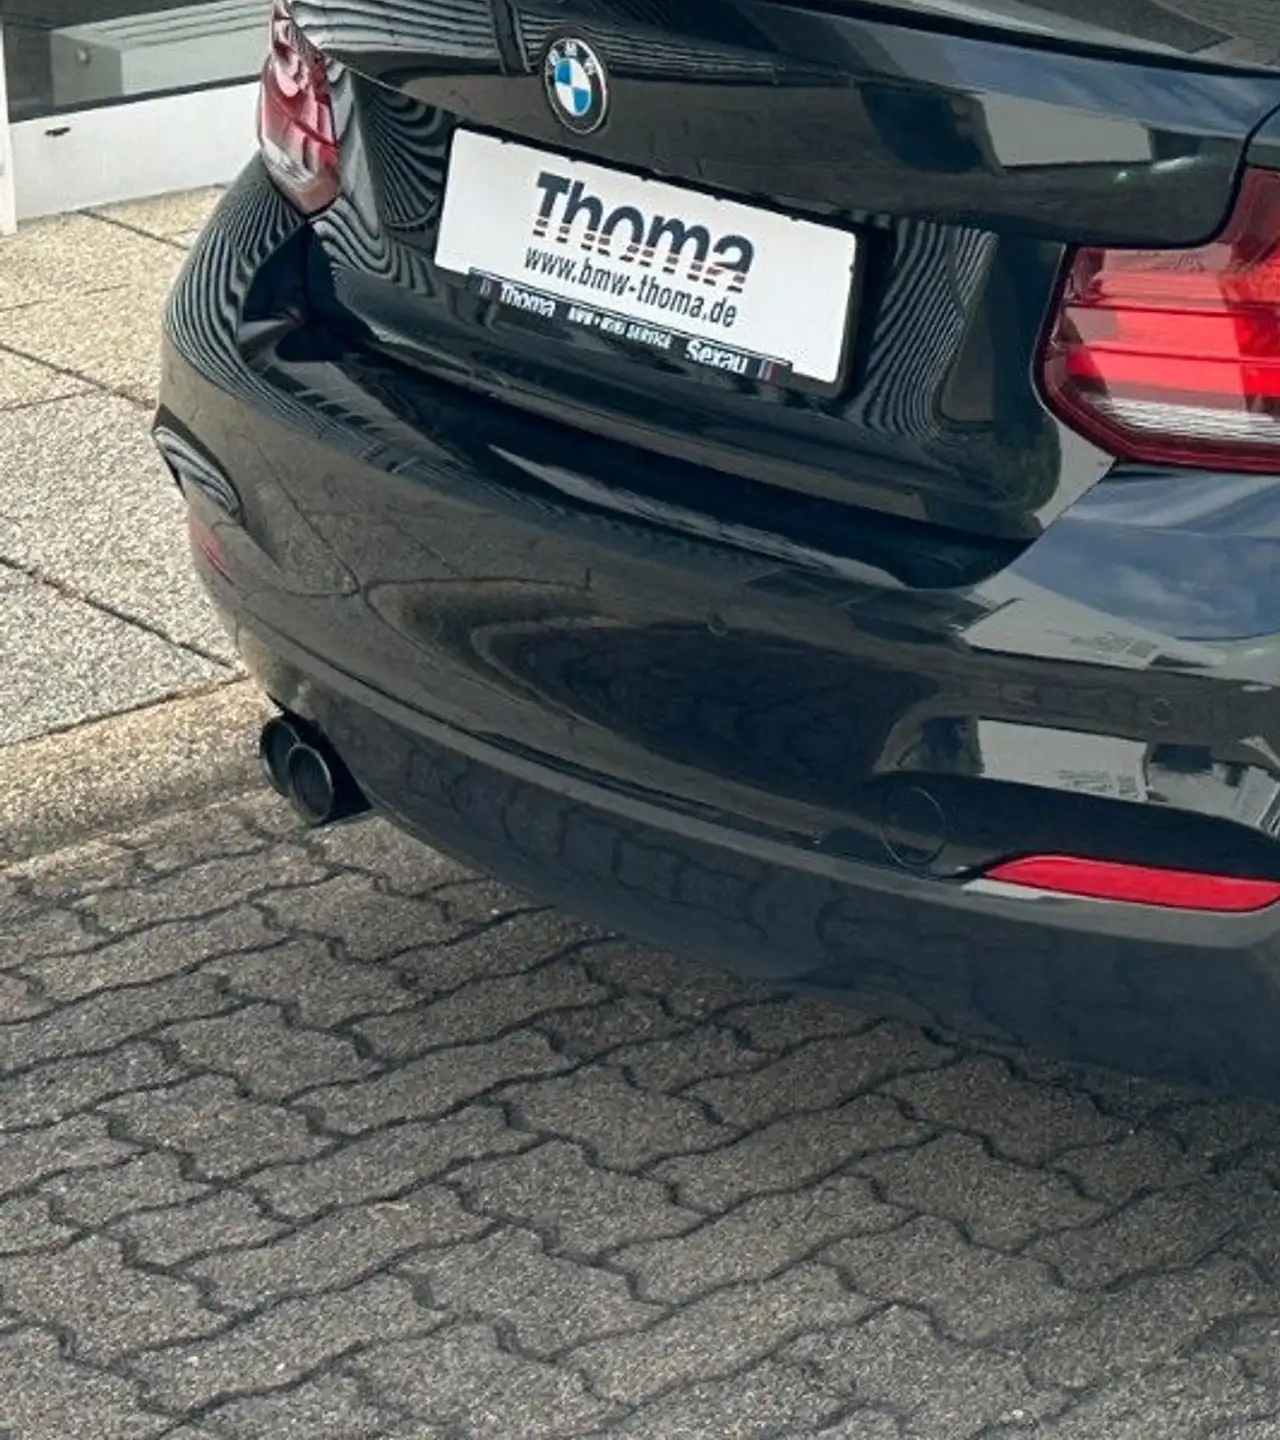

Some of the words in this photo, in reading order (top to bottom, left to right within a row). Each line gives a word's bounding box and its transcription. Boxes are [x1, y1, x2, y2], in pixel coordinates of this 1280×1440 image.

[533, 171, 755, 294] Thoma
[499, 281, 556, 317] Thoma
[686, 339, 748, 375] Sexau
[523, 245, 738, 328] www.bmw-thoma.de
